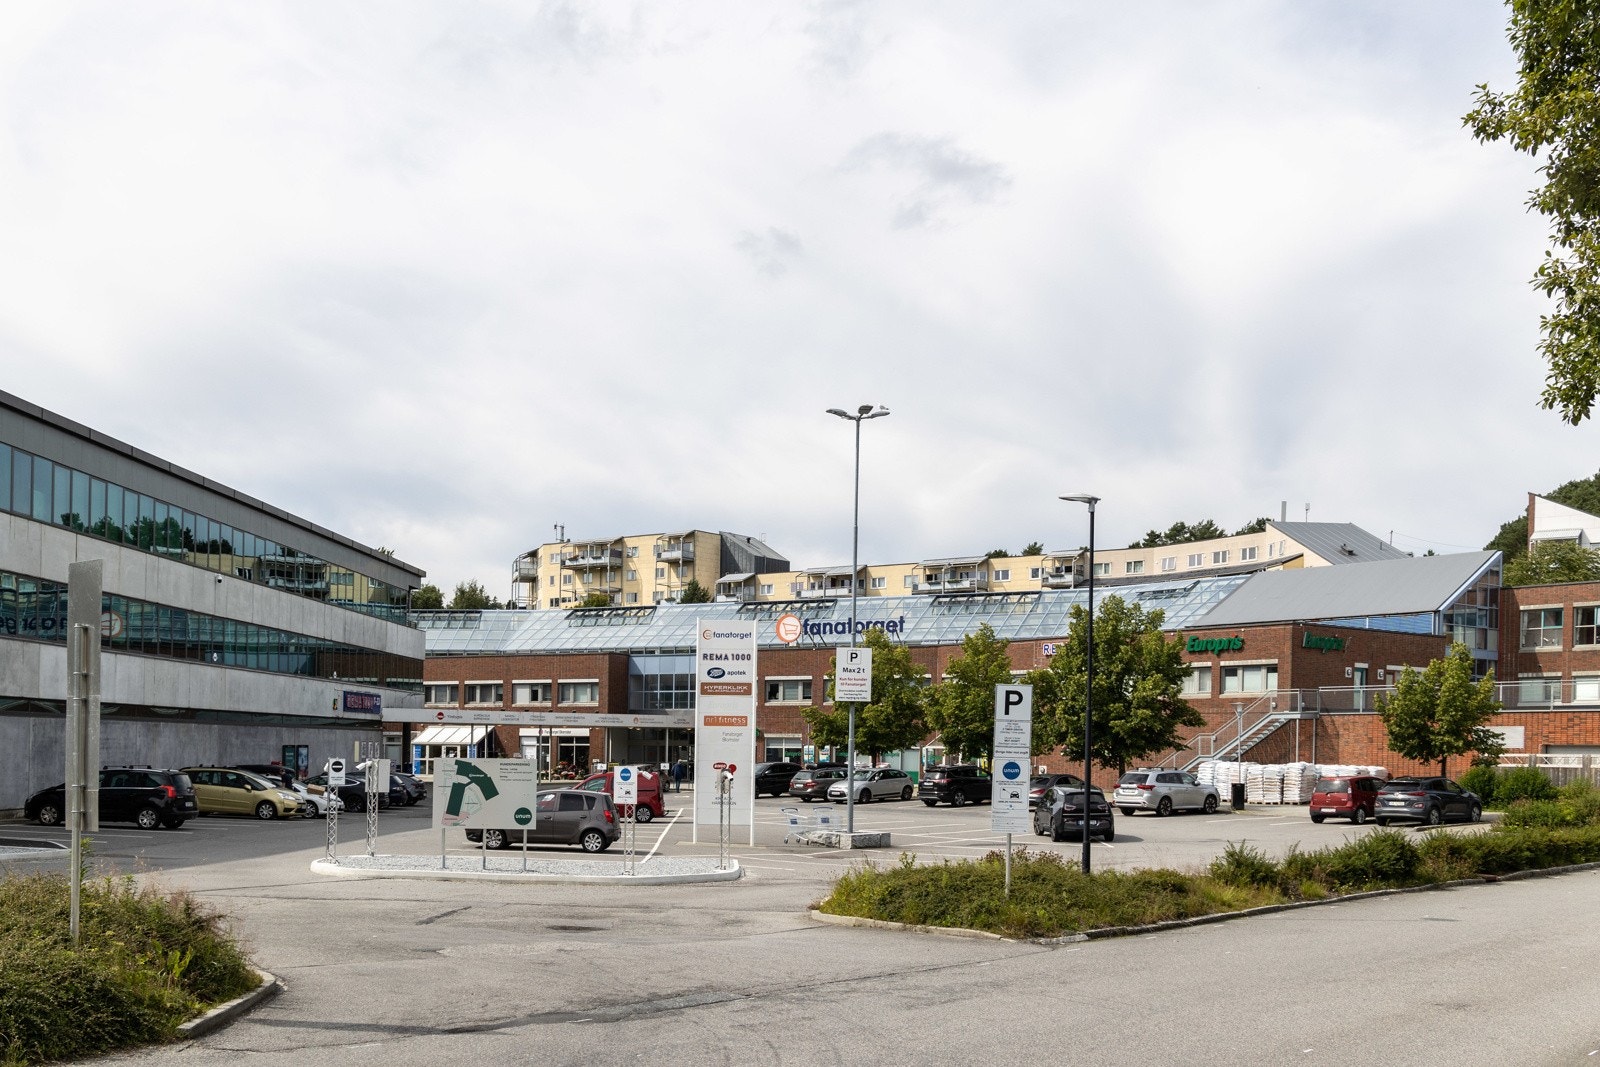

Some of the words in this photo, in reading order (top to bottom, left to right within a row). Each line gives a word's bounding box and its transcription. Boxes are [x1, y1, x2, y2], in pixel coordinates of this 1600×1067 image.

[1186, 635, 1243, 655] Europris
[702, 653, 729, 661] REMA
[731, 653, 752, 661] 1000
[850, 652, 858, 662] P
[1004, 690, 1023, 715] P
[718, 716, 746, 724] fitness
